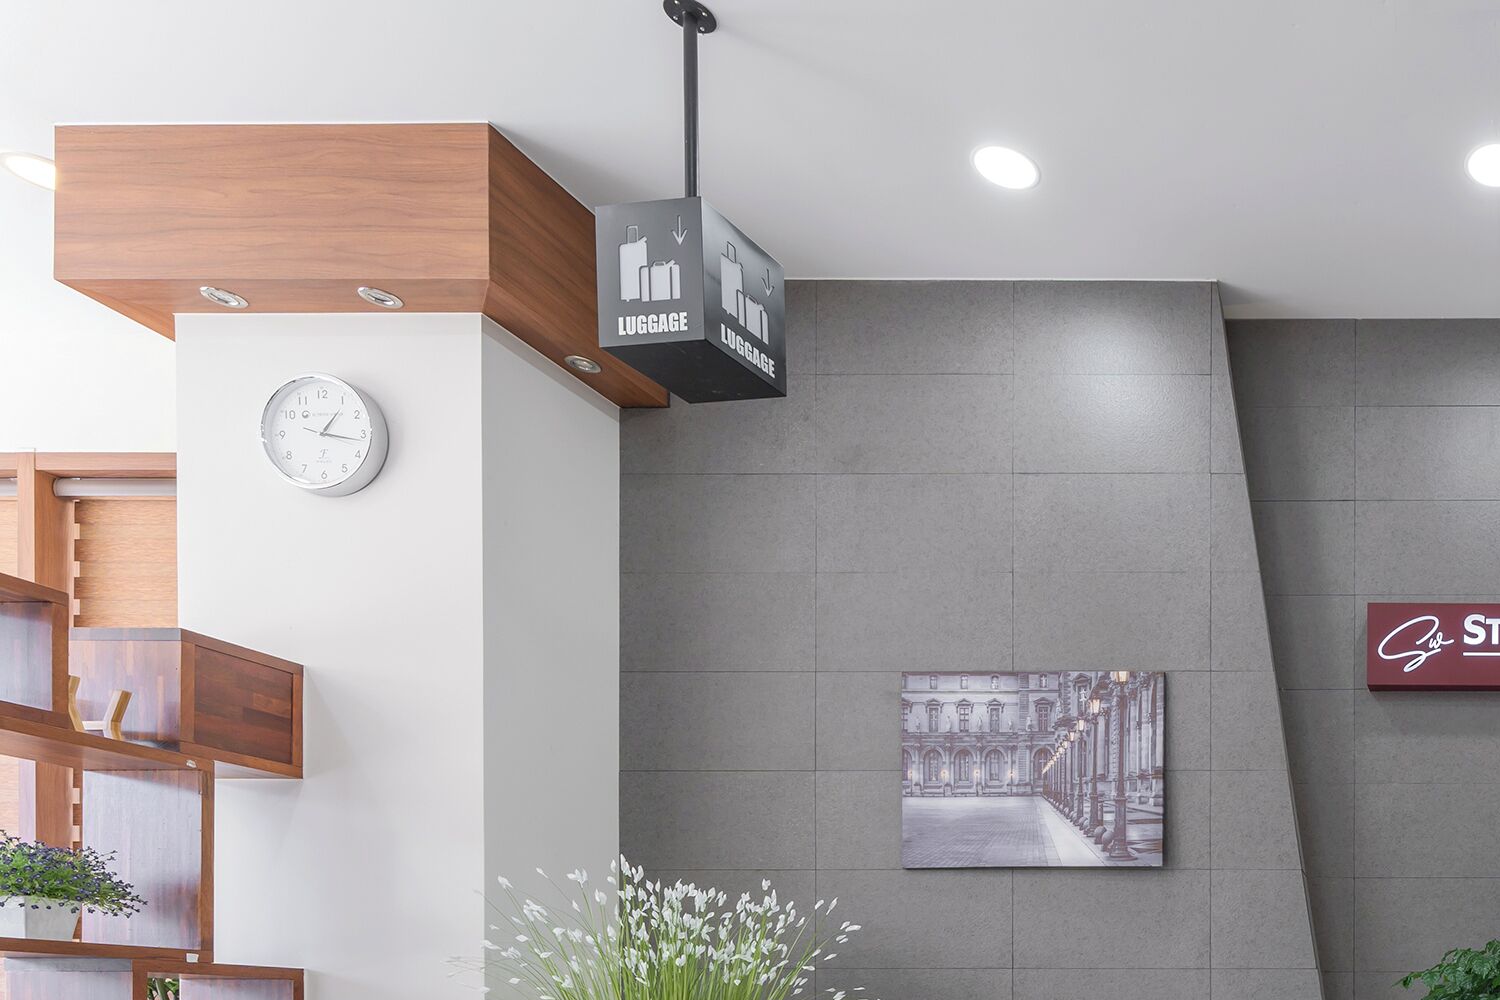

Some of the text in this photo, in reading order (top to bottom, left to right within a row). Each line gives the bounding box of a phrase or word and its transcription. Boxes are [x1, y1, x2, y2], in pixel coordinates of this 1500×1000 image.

[618, 312, 688, 336] LUGGAGE
[720, 323, 775, 379] LUGGAGE
[317, 389, 328, 399] 12
[298, 395, 308, 405] 11
[285, 410, 296, 419] 10
[354, 410, 360, 419] 2
[279, 430, 286, 440] 9
[360, 429, 366, 439] 3
[286, 450, 293, 460] 8
[354, 450, 361, 459] 4
[301, 464, 307, 473] 7
[341, 464, 348, 473] 5
[320, 470, 328, 479] 6
